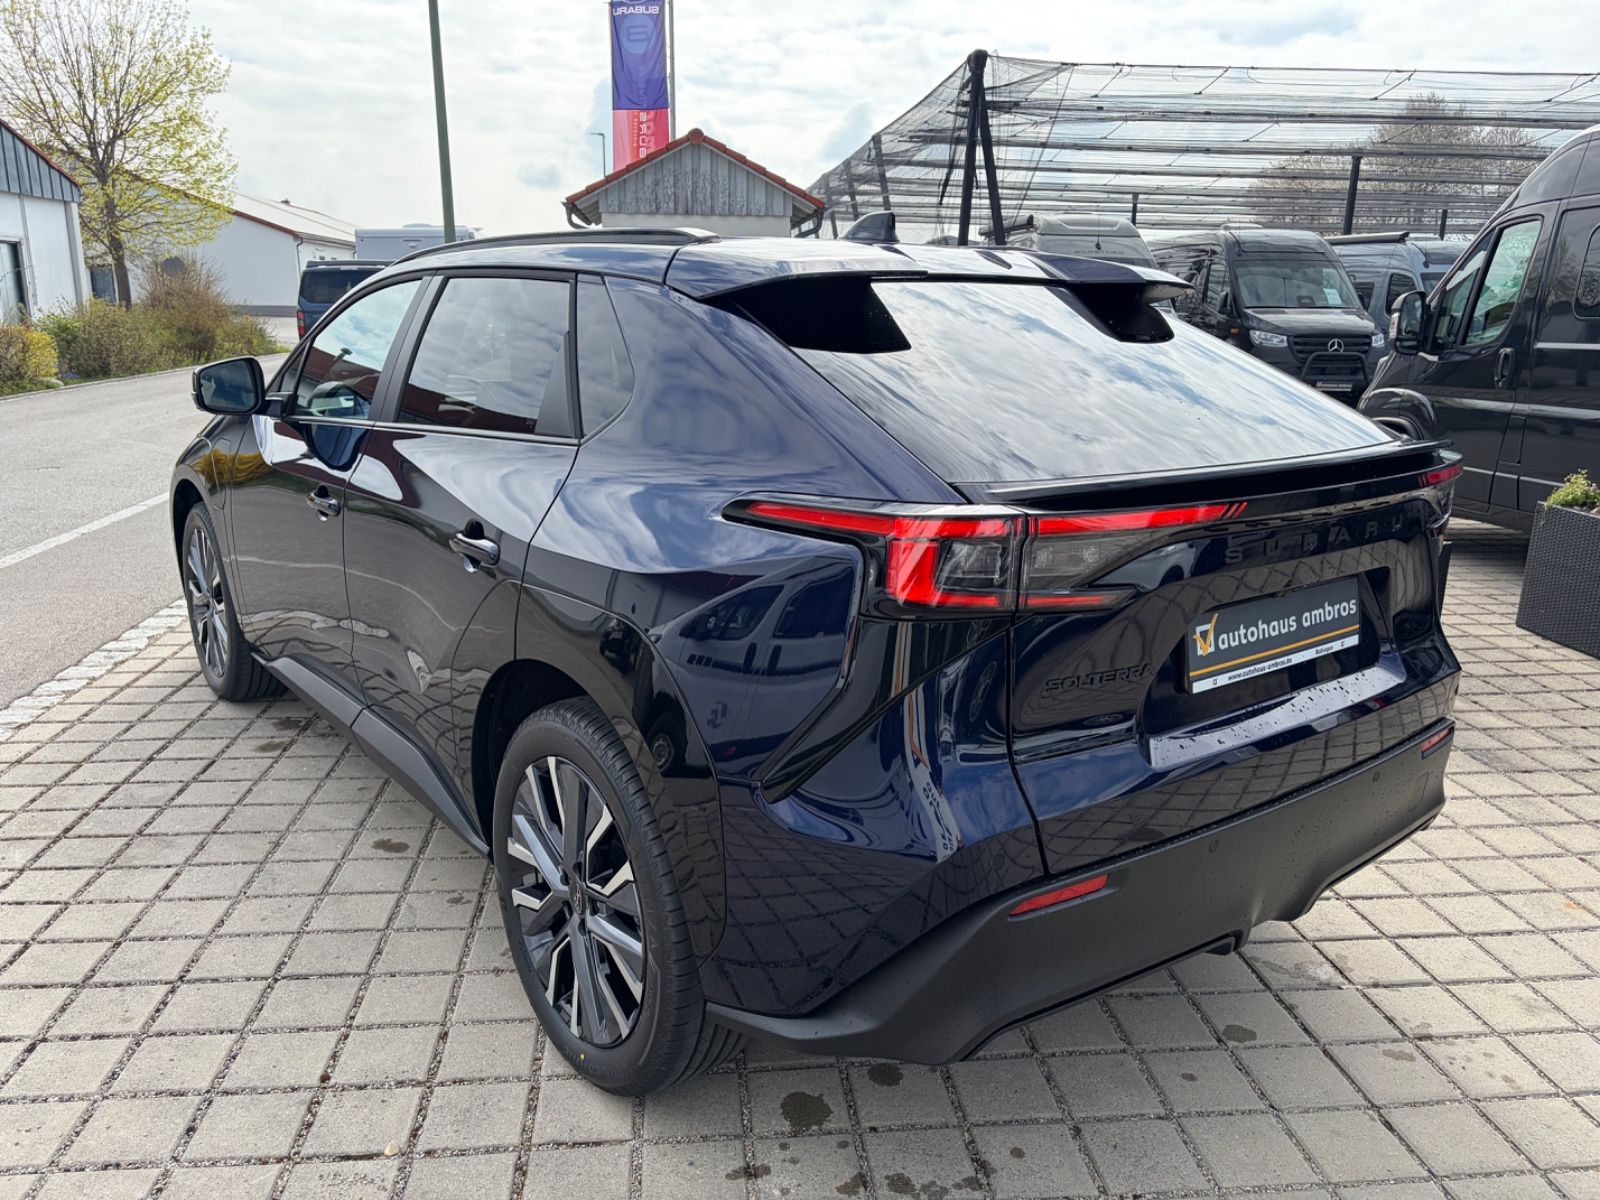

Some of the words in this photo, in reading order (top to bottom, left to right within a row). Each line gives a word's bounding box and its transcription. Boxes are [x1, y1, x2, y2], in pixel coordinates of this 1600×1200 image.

[1224, 514, 1403, 565] SUBARU
[1218, 614, 1298, 650] autohaus
[1302, 598, 1357, 628] ambros
[1044, 662, 1154, 692] SOLTERRA
